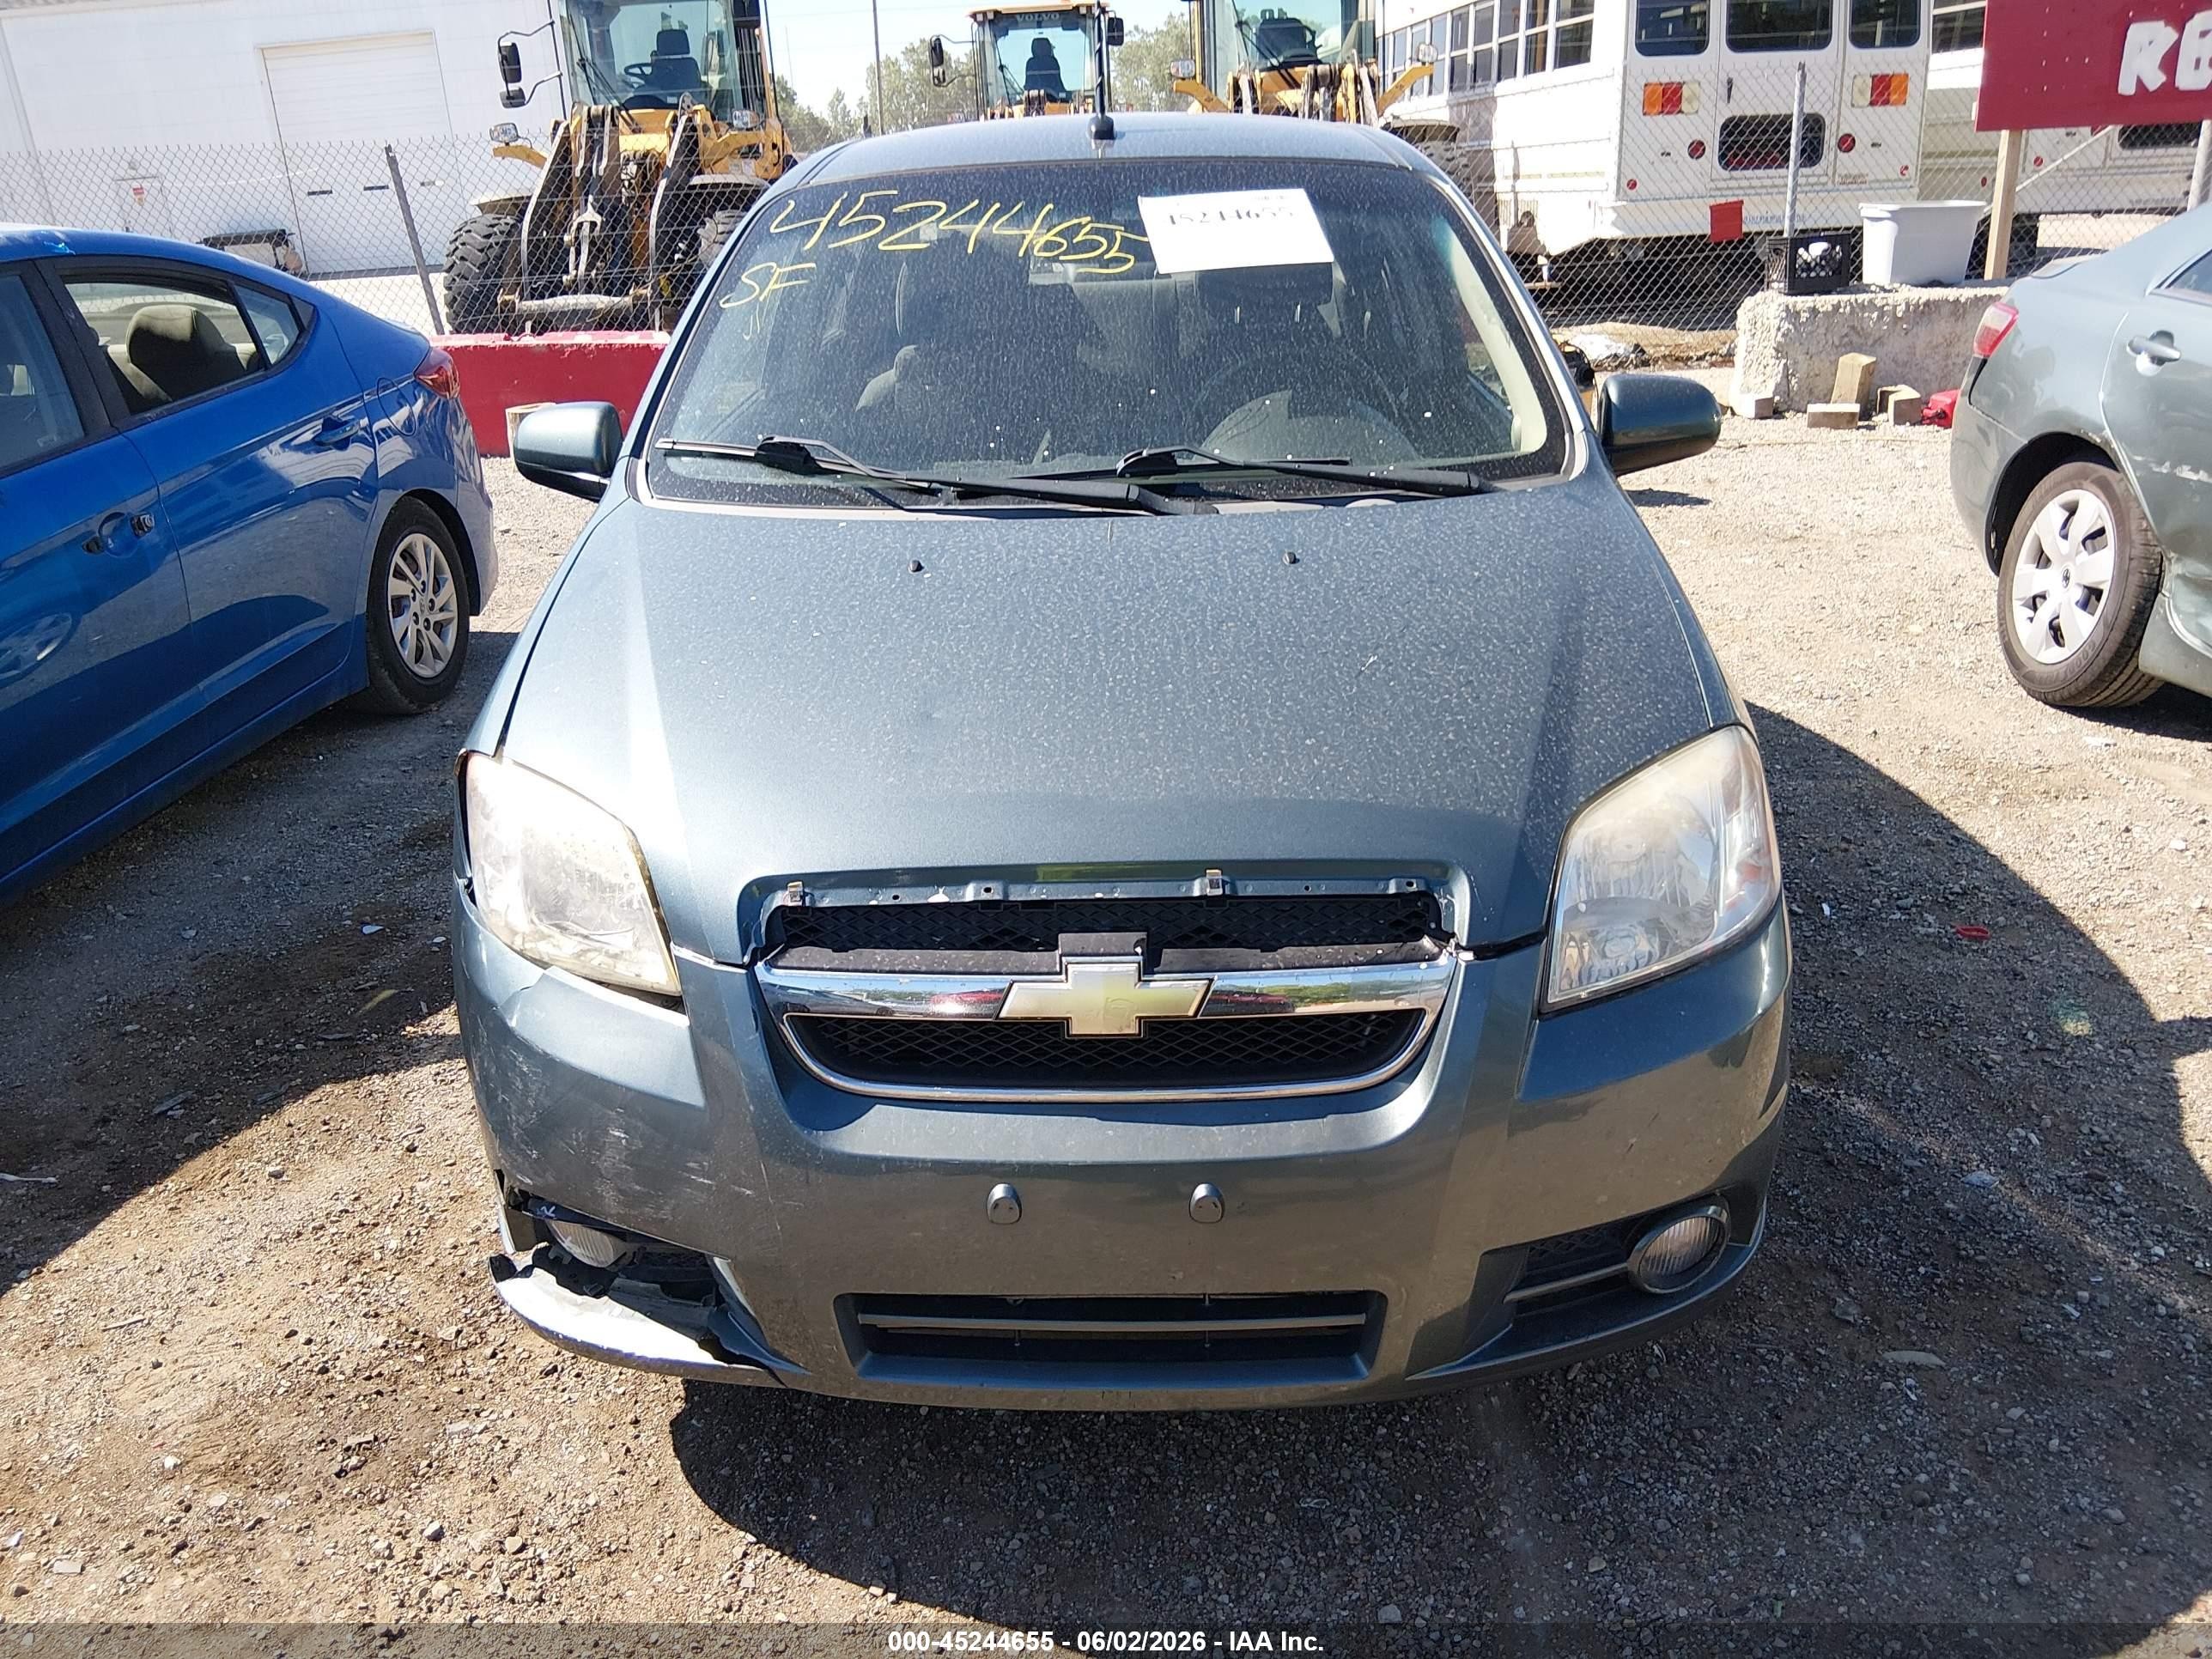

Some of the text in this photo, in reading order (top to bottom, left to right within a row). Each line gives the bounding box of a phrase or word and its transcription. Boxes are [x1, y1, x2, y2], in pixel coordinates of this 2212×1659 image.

[1016, 12, 1060, 21] VOLVO
[769, 190, 1149, 274] 45244655
[719, 261, 817, 308] SF
